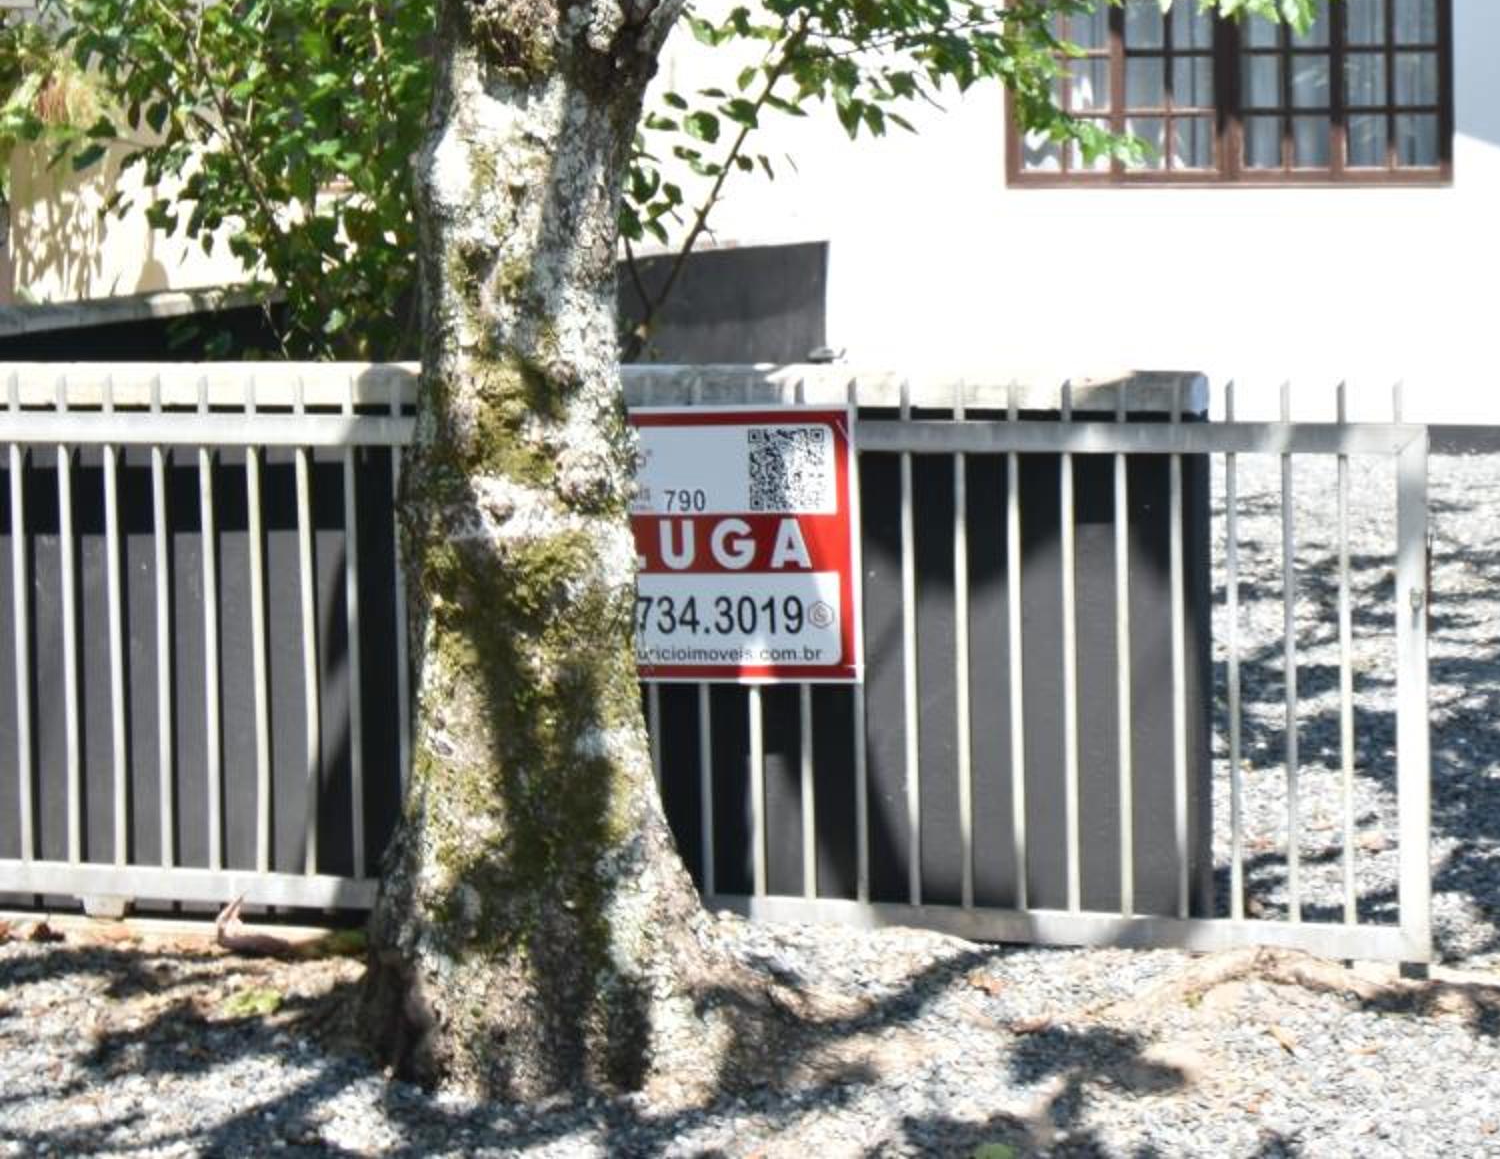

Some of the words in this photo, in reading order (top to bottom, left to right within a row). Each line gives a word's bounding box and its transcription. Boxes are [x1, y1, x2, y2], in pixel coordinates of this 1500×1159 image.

[664, 488, 707, 512] 790
[636, 518, 812, 570] UGA
[637, 595, 803, 635] 734.3019
[637, 645, 822, 662] uricioimoveiscom.br
